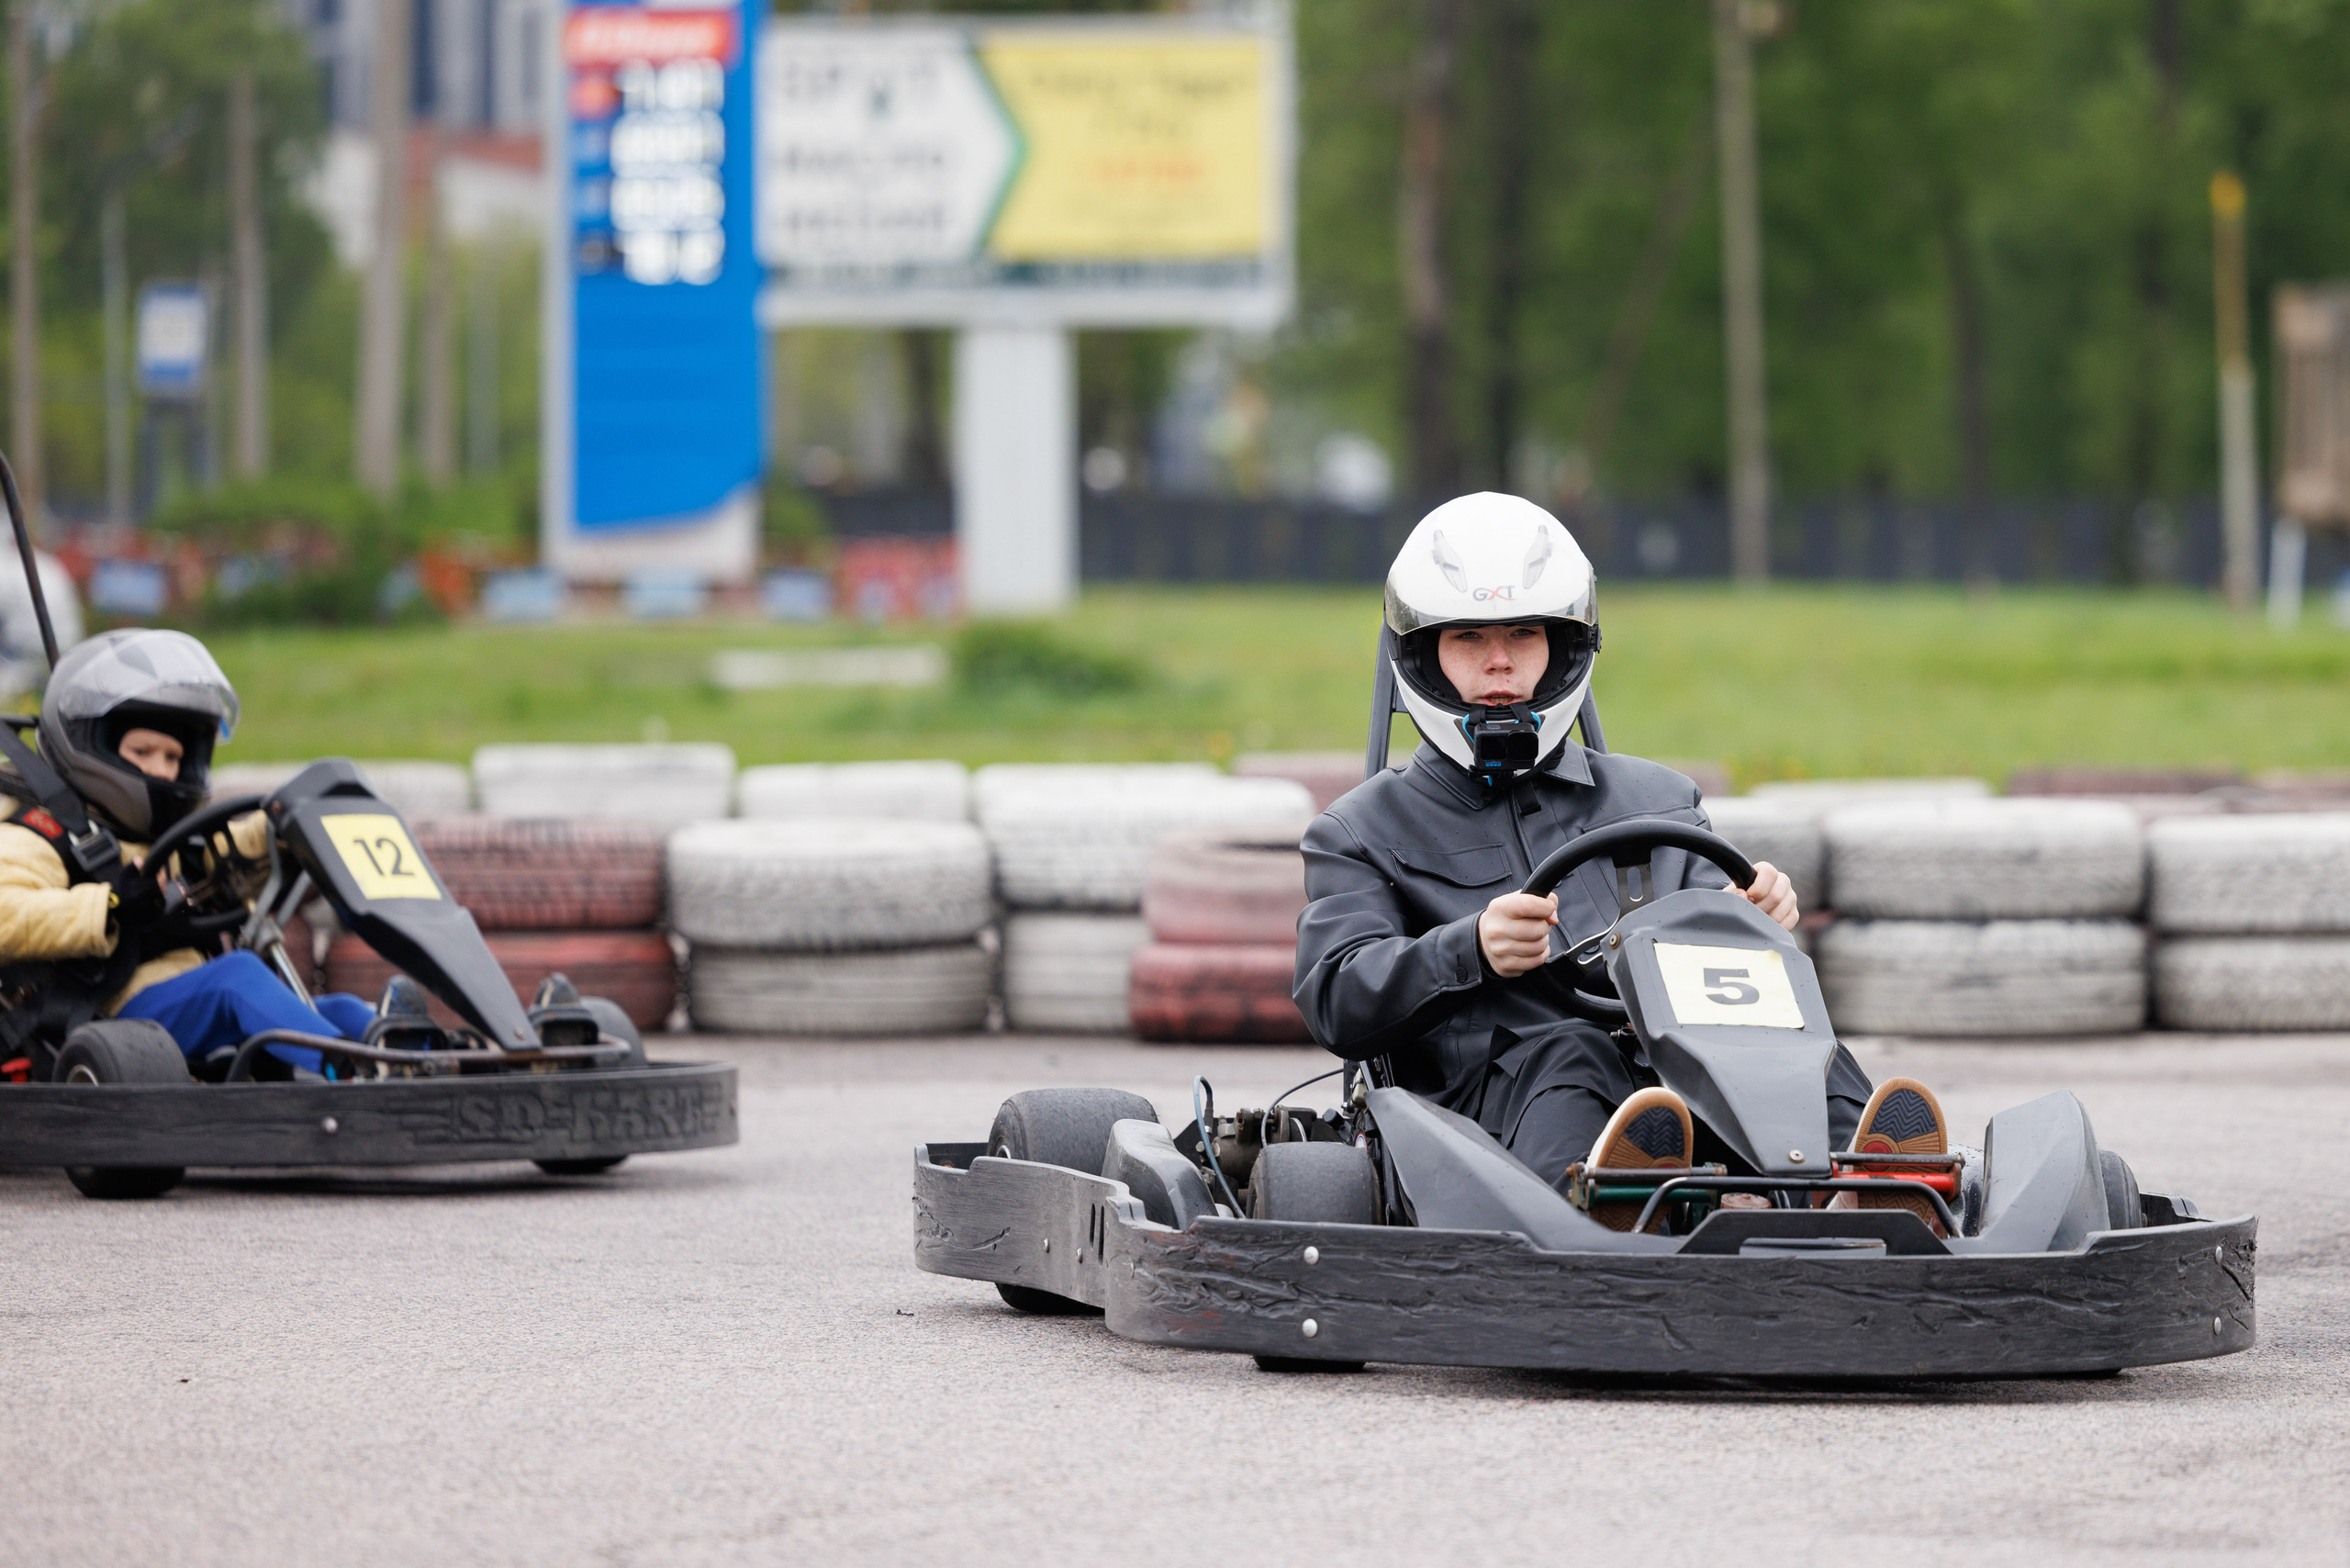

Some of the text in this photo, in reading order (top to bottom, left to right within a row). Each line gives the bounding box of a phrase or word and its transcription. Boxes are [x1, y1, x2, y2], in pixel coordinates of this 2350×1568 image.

[1472, 585, 1516, 601] GXT
[352, 837, 416, 877] 12
[1703, 967, 1761, 1006] 5
